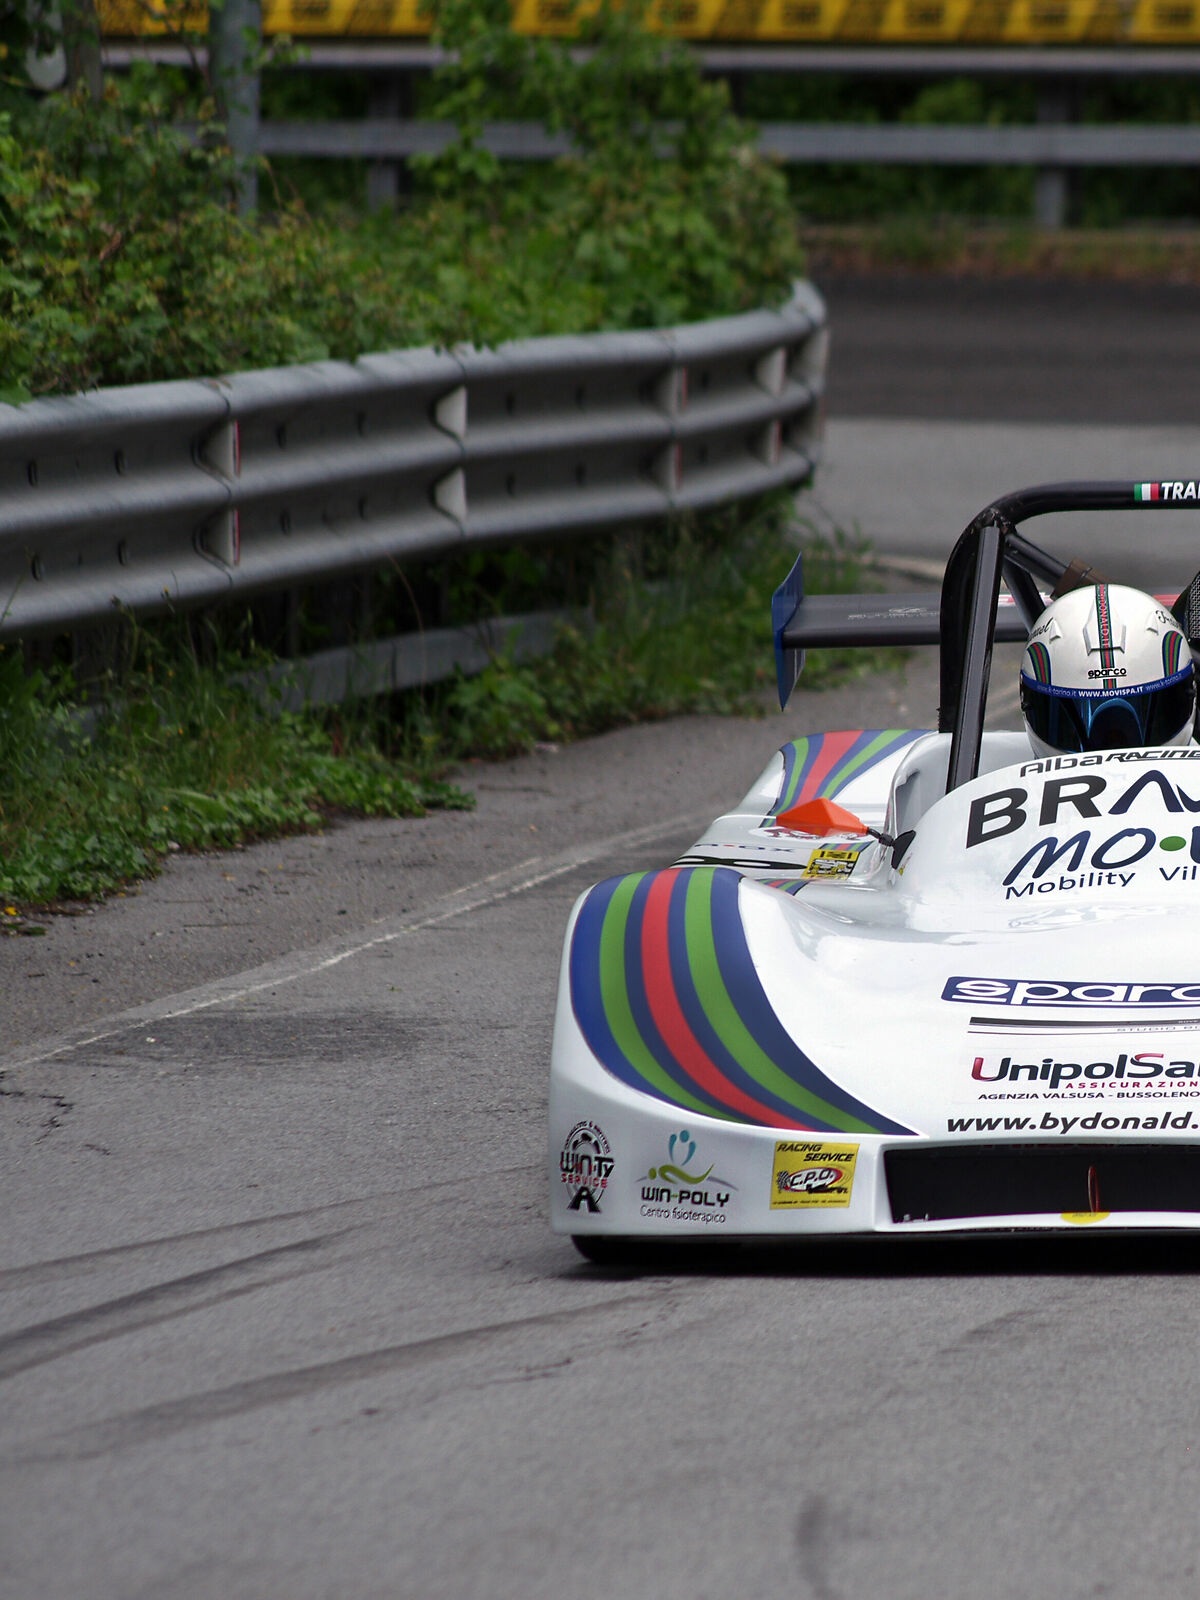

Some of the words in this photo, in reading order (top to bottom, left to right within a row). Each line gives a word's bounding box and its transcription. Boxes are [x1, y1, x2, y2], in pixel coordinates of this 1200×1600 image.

[1088, 667, 1127, 679] sparco
[1078, 686, 1143, 699] WWW.MOVISPA.IT
[1005, 872, 1136, 900] Mobility
[978, 1092, 1038, 1100] AGENZIA
[1043, 1091, 1104, 1099] VALSUSA
[1117, 1090, 1200, 1098] BUSSOLENO
[777, 1143, 823, 1152] RACING
[803, 1153, 855, 1162] SERVICE
[561, 1173, 608, 1189] SERVICE
[640, 1204, 670, 1218] Centro
[672, 1206, 726, 1224] fisioterapico
